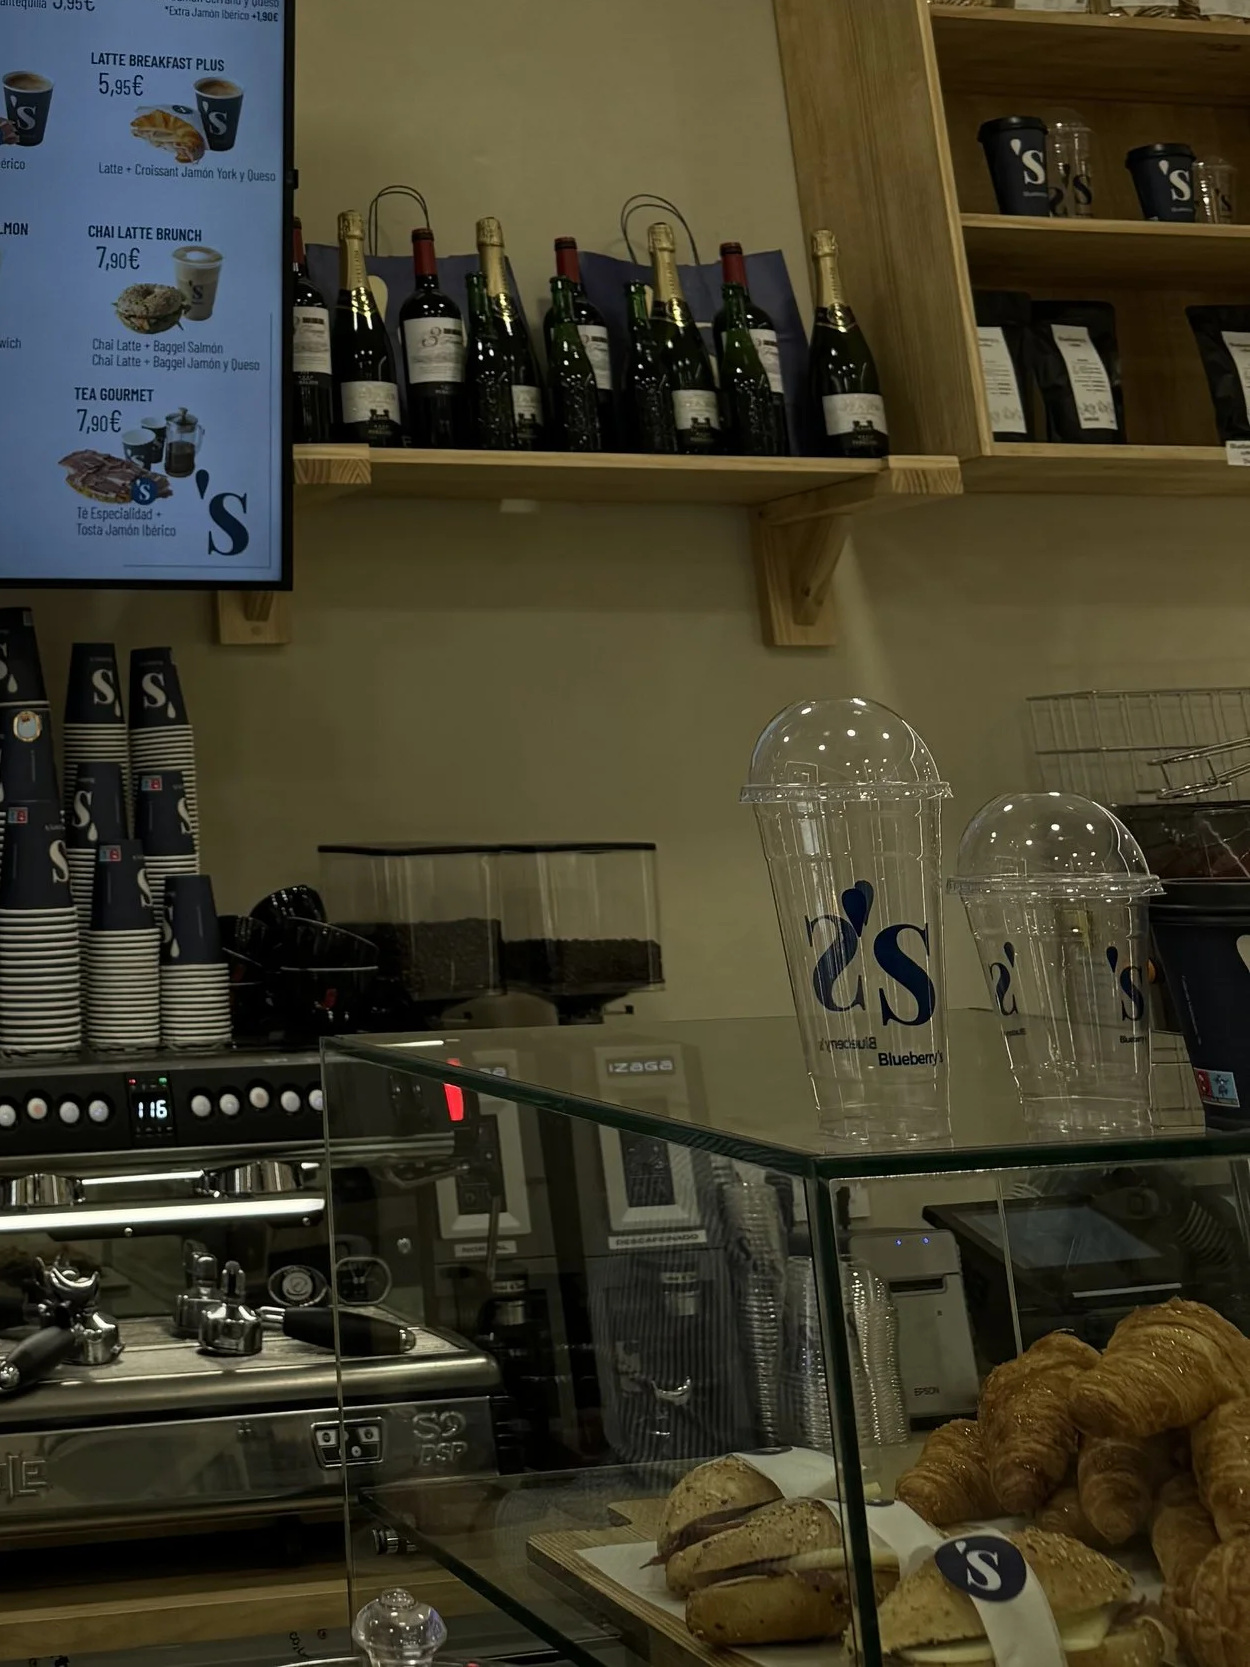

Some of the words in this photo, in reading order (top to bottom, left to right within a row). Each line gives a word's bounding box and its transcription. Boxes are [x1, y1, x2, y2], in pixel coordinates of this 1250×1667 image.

[91, 52, 126, 66] LATTE
[129, 54, 193, 70] BREAKFAST
[196, 58, 224, 72] PLUS
[99, 72, 144, 97] 5,95€
[88, 225, 114, 238] CHAI
[117, 226, 153, 240] LATTE
[156, 227, 202, 242] BRUNCH
[96, 246, 140, 271] 7,90€
[74, 387, 97, 401] TEA
[100, 388, 154, 402] GOURMET
[76, 408, 122, 434] 7,90€
[877, 1050, 944, 1066] Blueberry's
[138, 1099, 168, 1119] 116
